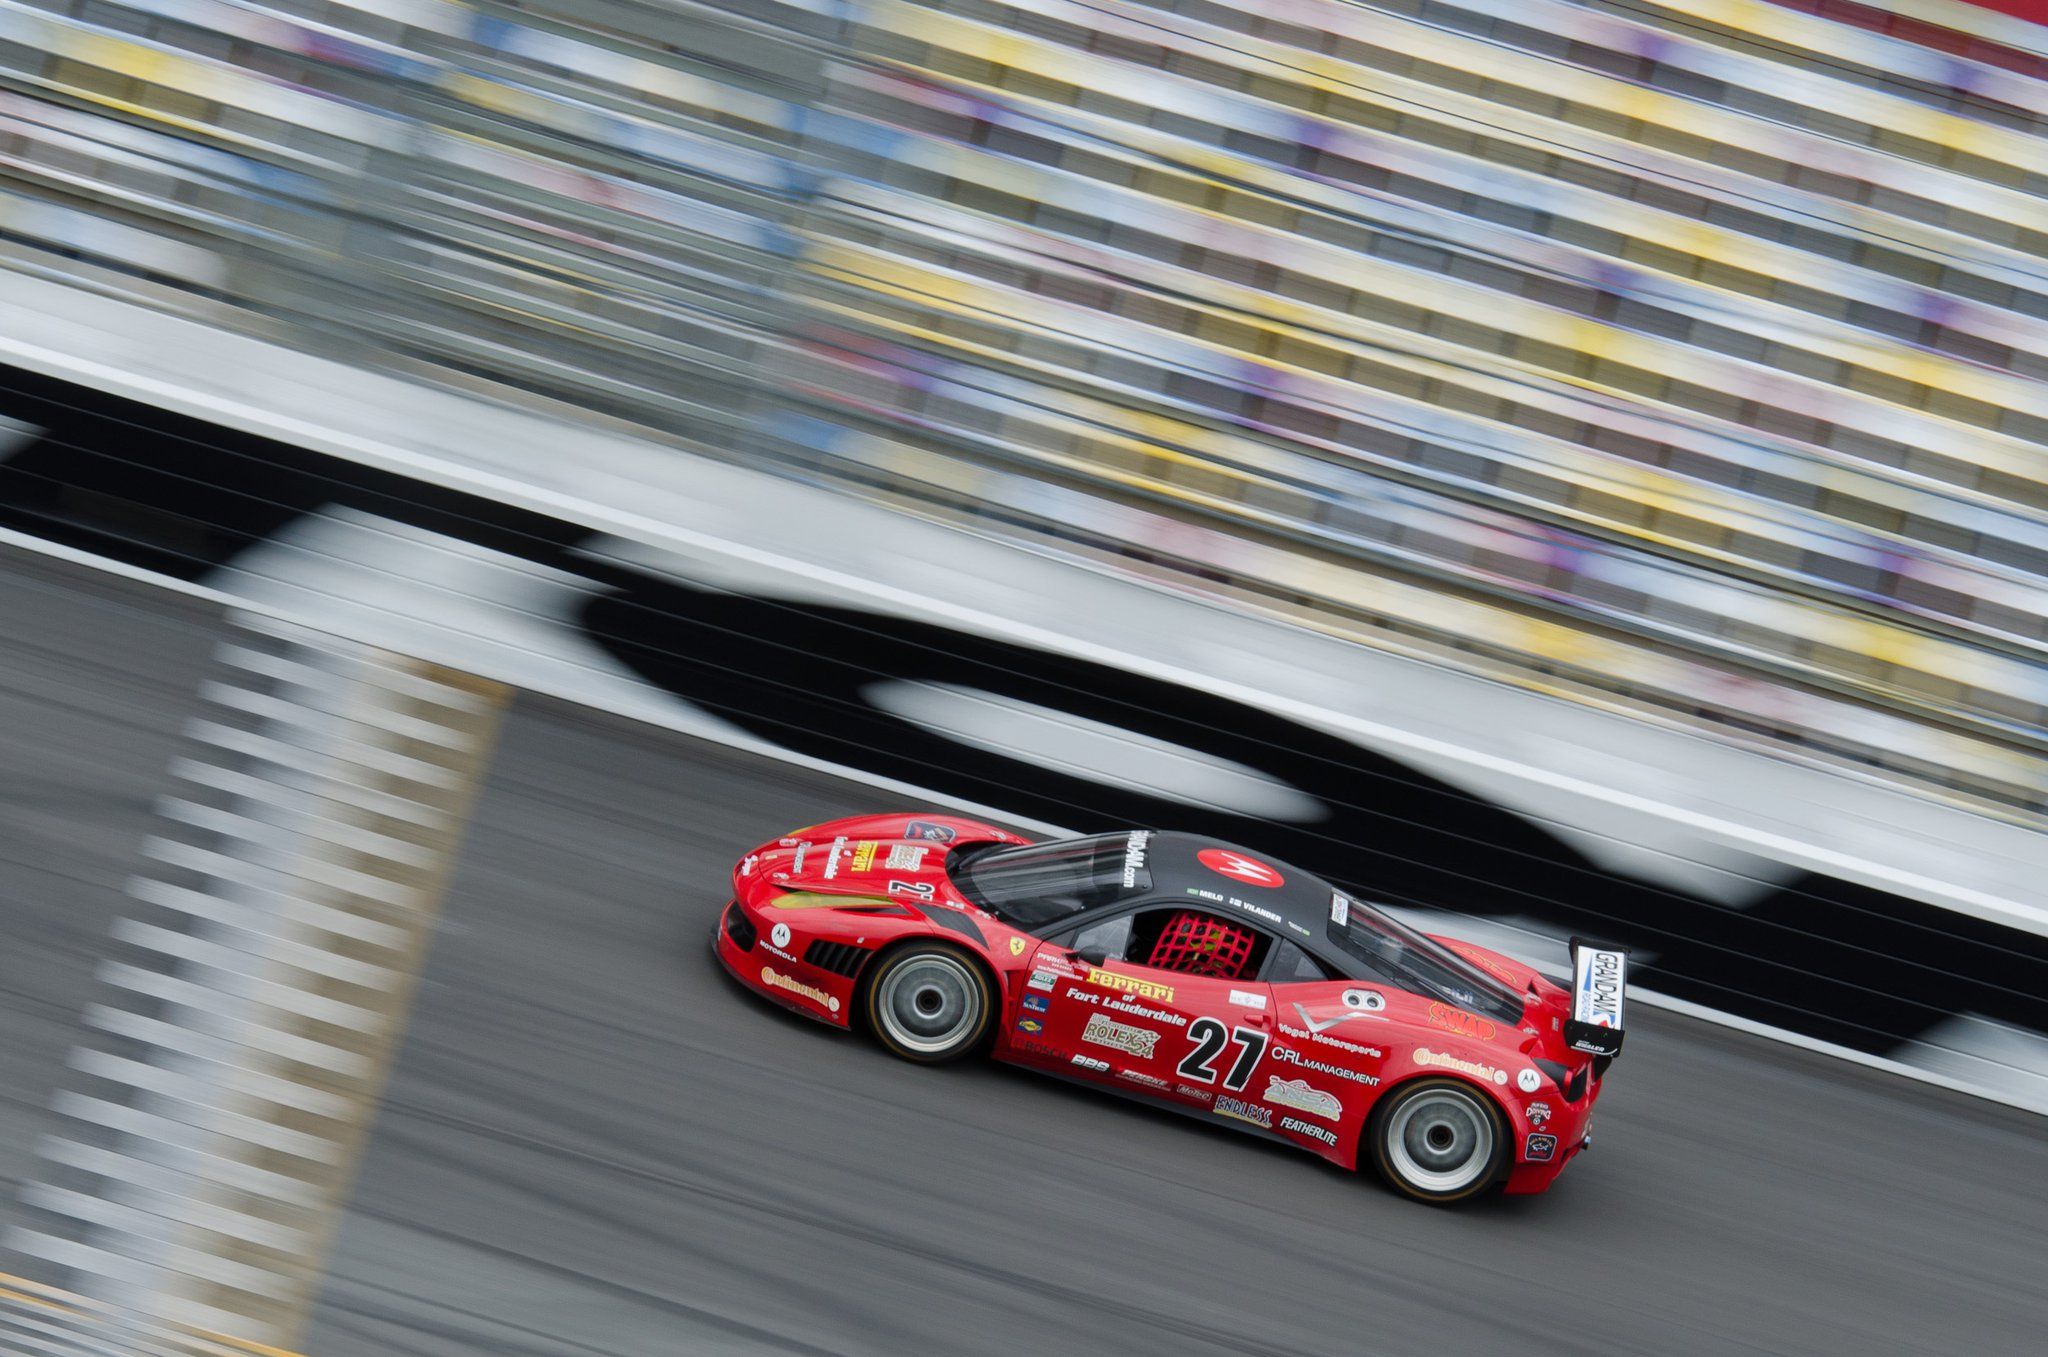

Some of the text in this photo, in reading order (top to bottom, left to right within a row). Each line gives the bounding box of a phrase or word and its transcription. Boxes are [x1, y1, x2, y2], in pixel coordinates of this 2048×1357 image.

[1199, 889, 1223, 902] MELO
[1243, 901, 1281, 923] VILANDER
[760, 939, 797, 963] MOTOROLA
[761, 966, 829, 1007] Continental
[1086, 966, 1174, 1004] Ferrari
[1122, 994, 1136, 1003] of
[1066, 988, 1099, 1006] Fort
[1102, 997, 1188, 1028] Lauderdale
[1085, 1022, 1131, 1048] ROLEX
[1278, 1023, 1382, 1058] Vogel Motorsports
[1575, 1042, 1605, 1053] WHALER
[1070, 1053, 1110, 1073] BBS
[1176, 1016, 1269, 1092] 27
[1413, 1047, 1494, 1081] Continental
[1215, 1095, 1271, 1123] ENDLESS
[1279, 1117, 1338, 1147] FEATHERLITE
